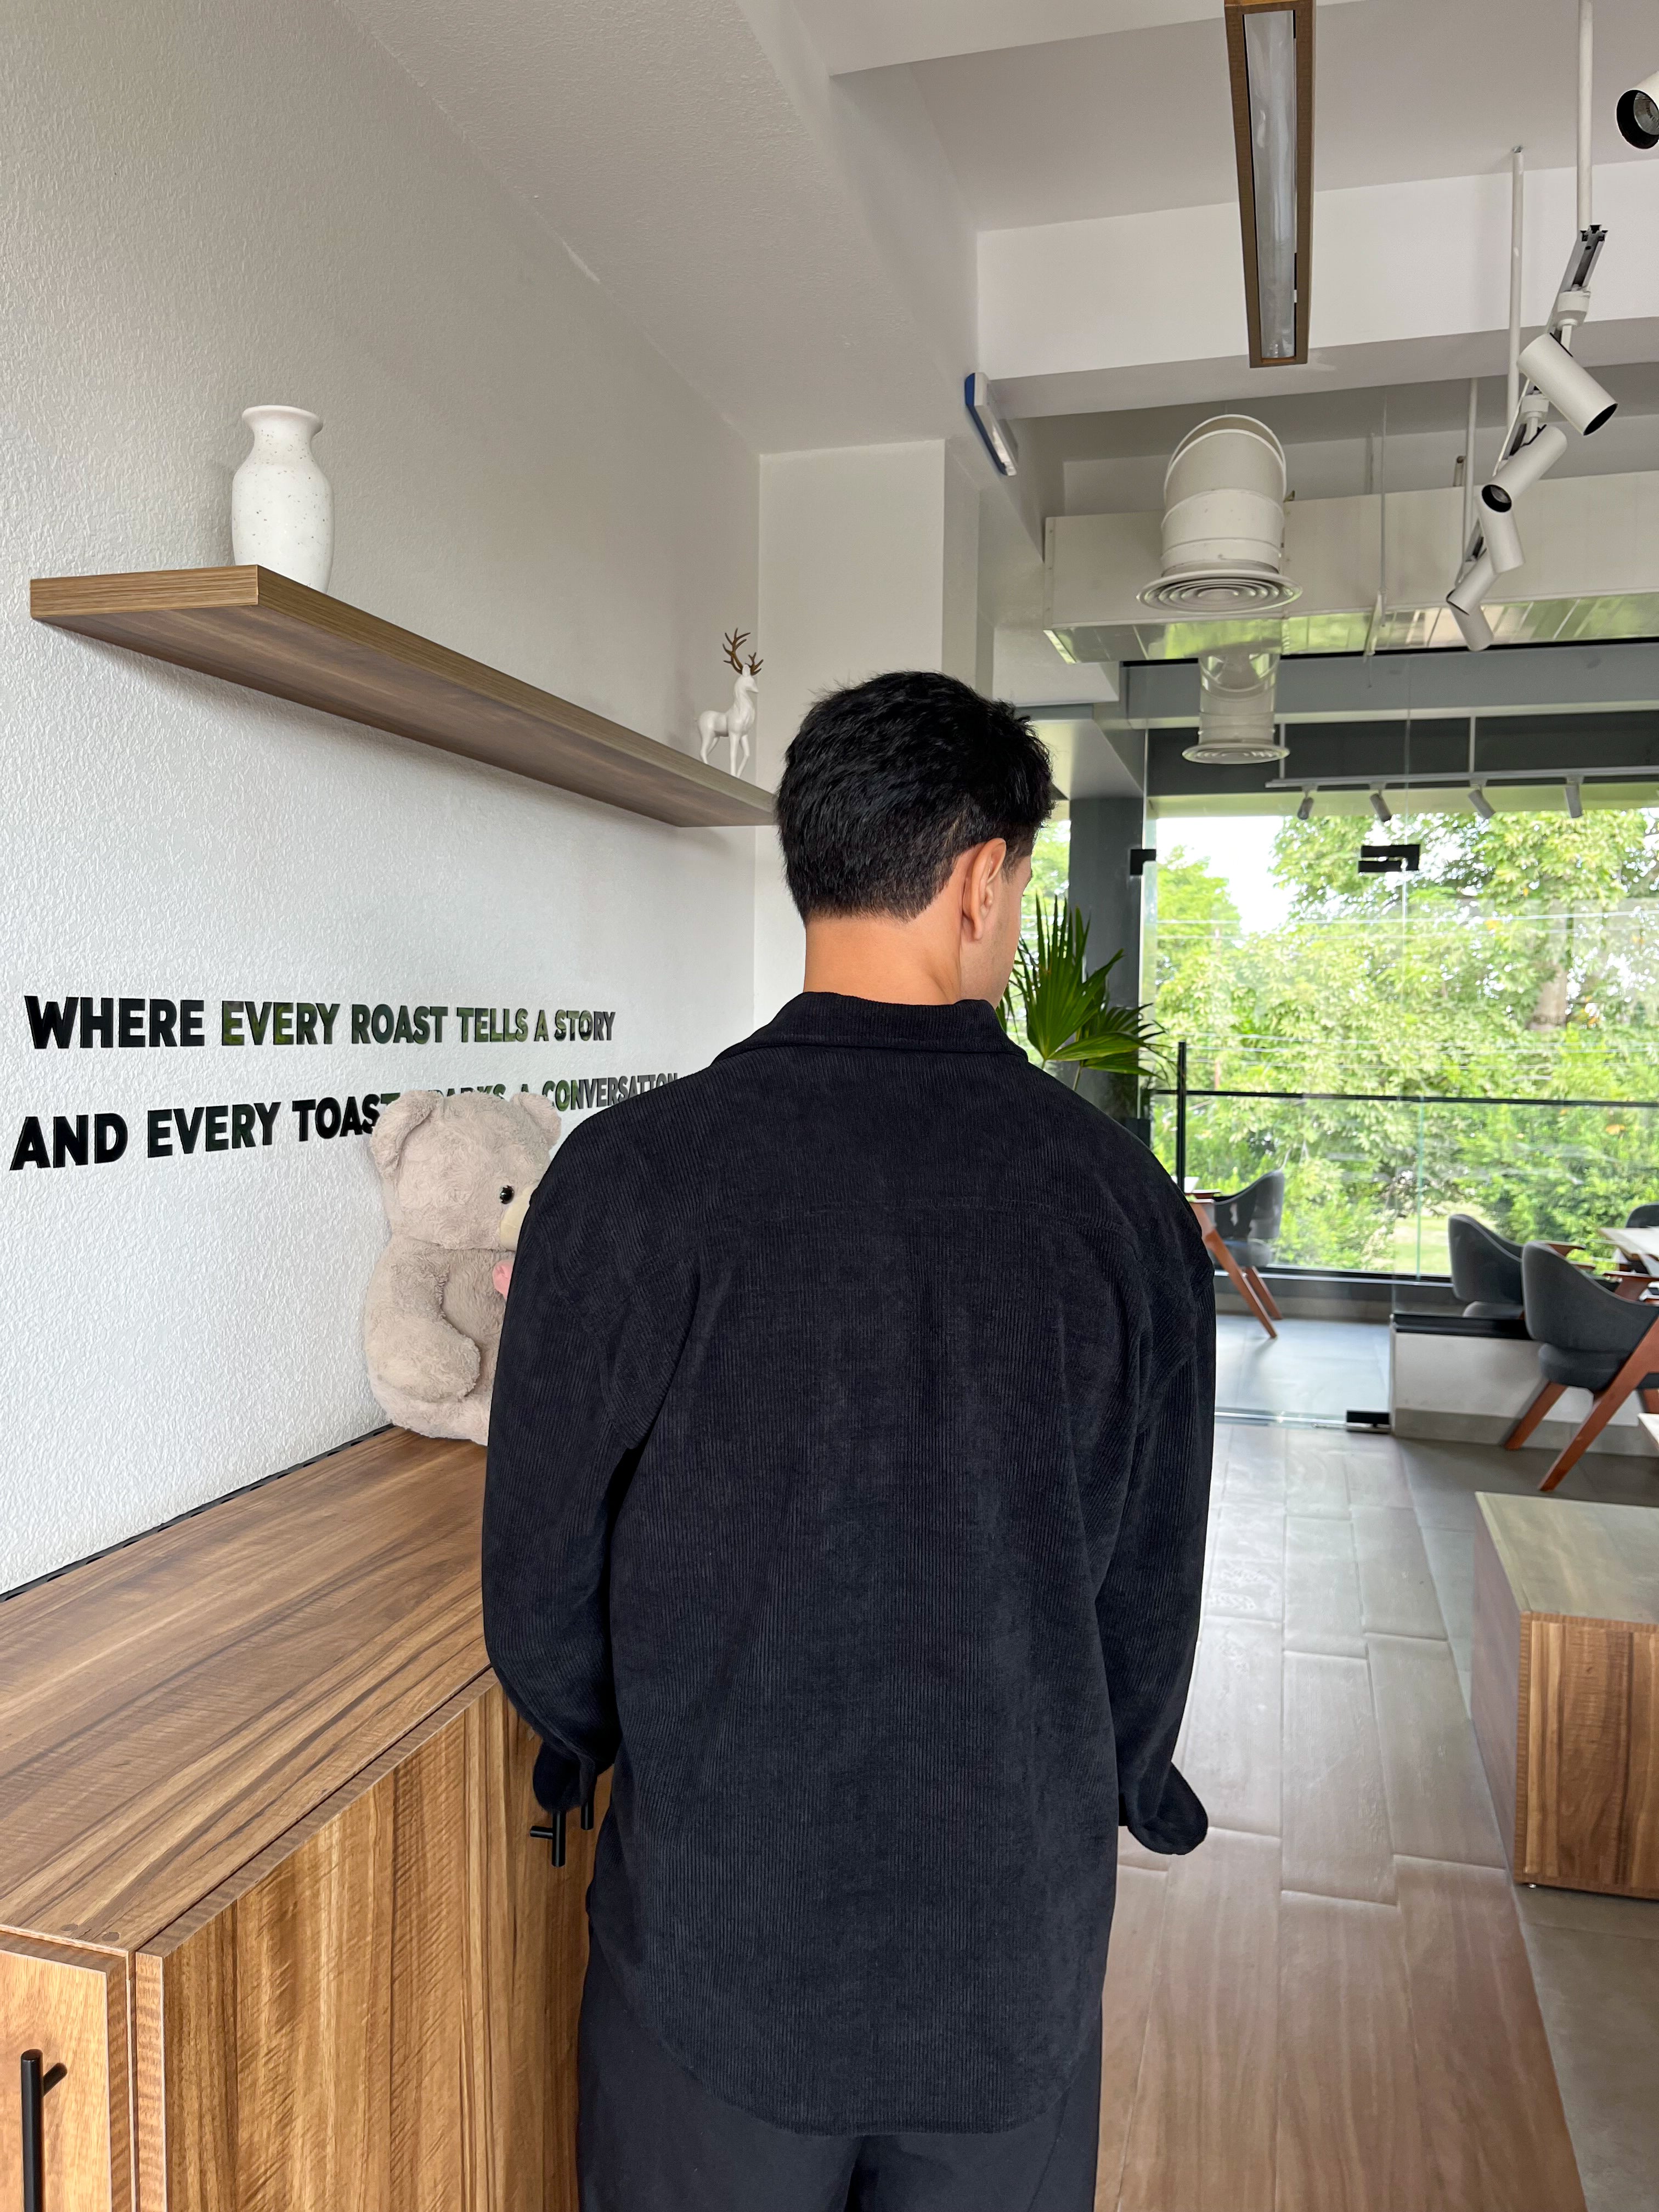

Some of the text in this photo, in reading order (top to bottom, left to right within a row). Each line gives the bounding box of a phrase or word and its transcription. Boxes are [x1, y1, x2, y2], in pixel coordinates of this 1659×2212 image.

[24, 996, 616, 1049] WHERE EVERY ROAST TELLS A STORY
[9, 1113, 128, 1171] AND
[147, 1102, 281, 1158] EVERY
